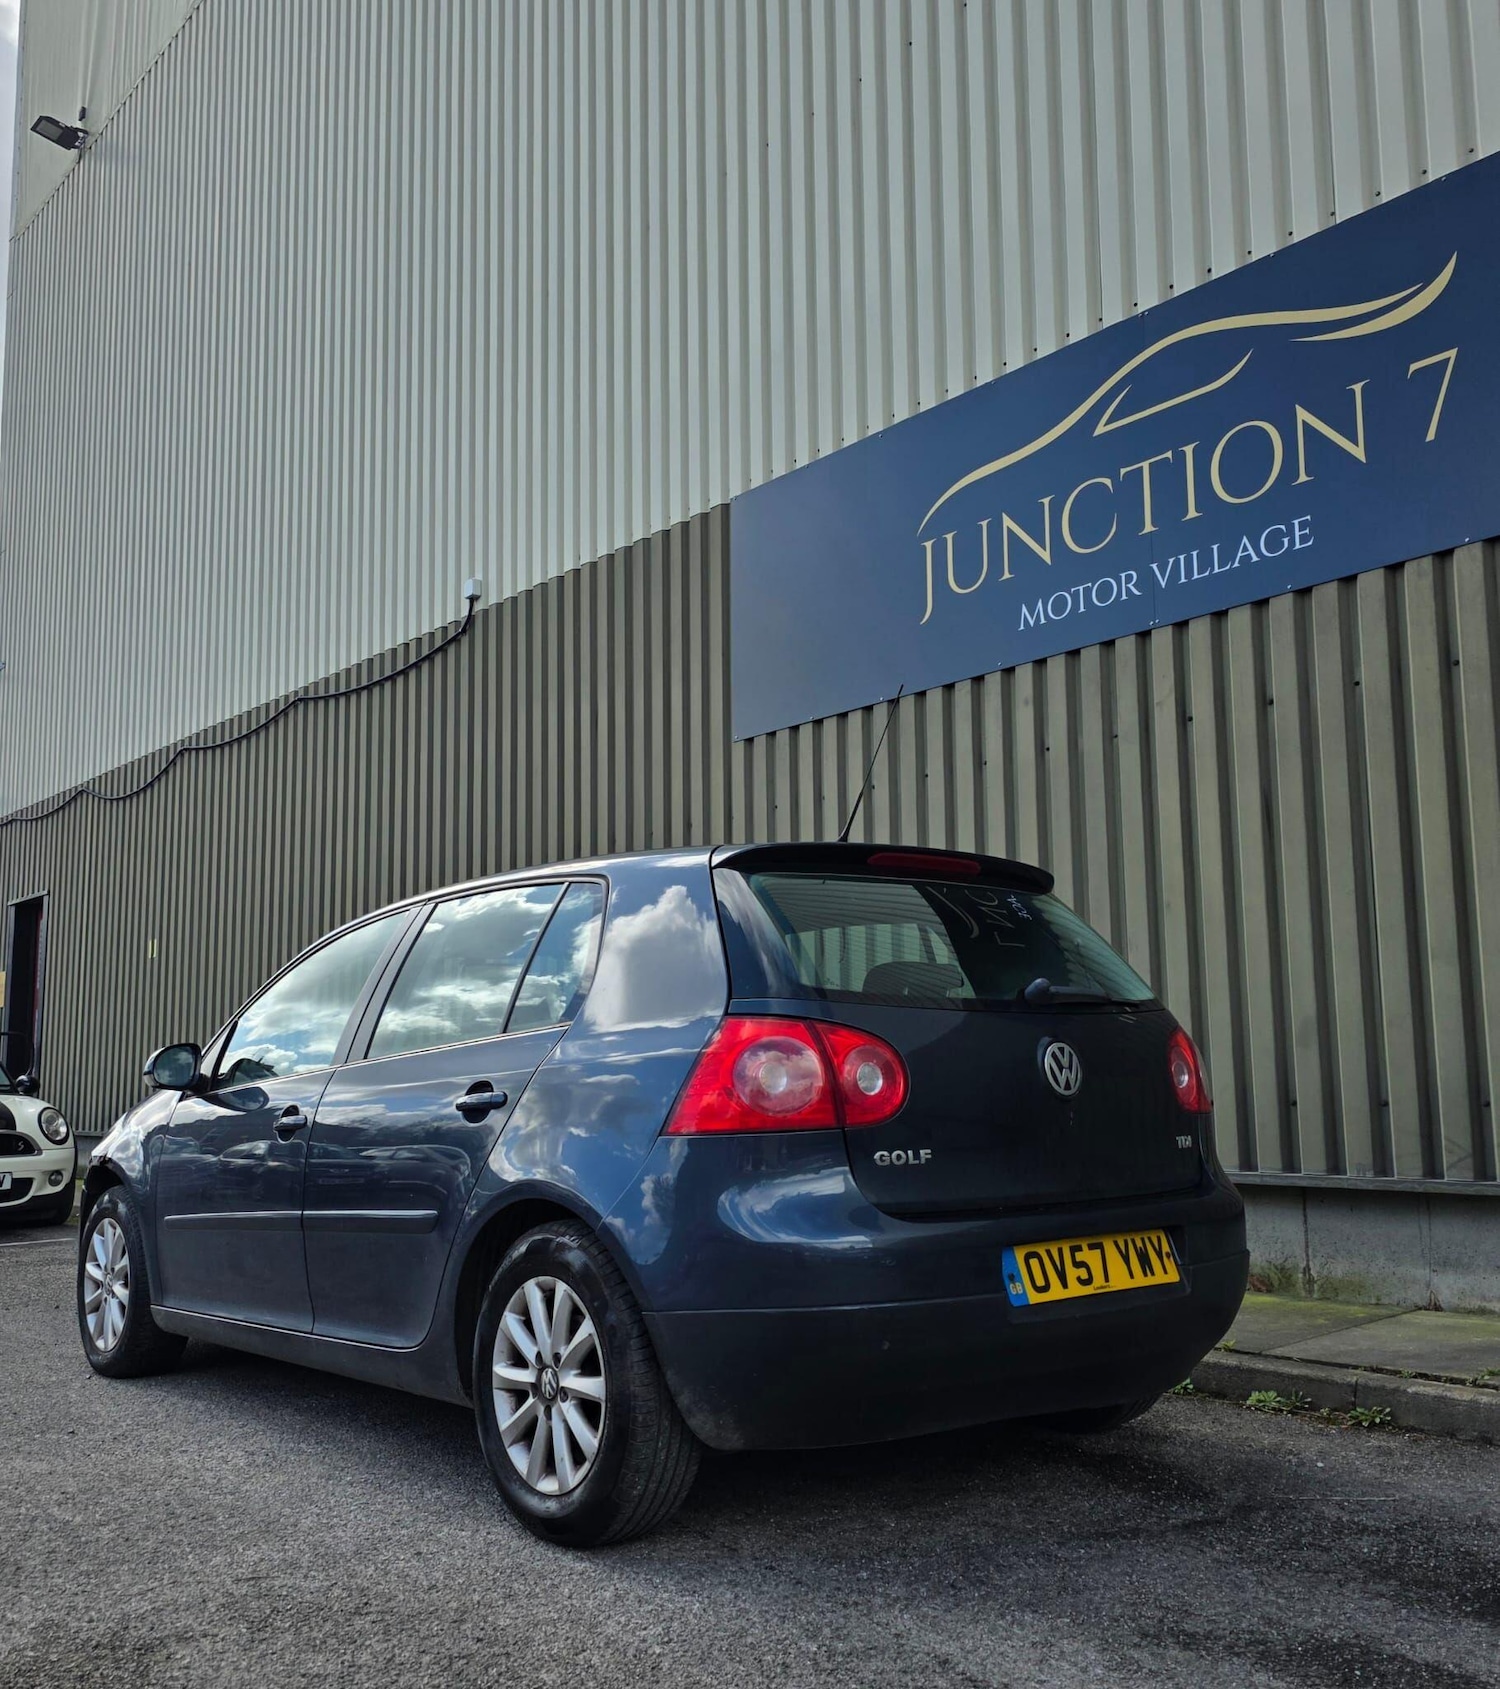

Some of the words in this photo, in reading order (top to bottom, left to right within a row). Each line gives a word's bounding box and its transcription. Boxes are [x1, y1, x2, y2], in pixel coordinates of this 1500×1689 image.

[919, 379, 1371, 625] JUNCTION
[1406, 347, 1458, 443] 7
[1017, 570, 1143, 631] MOTOR
[1148, 515, 1315, 590] VILLAGE
[1045, 1042, 1081, 1096] VW
[873, 1149, 932, 1166] GOLF
[1175, 1135, 1193, 1149] TDI
[1009, 1282, 1024, 1295] GB
[1023, 1241, 1110, 1294] OV57
[1113, 1235, 1169, 1280] YWY
